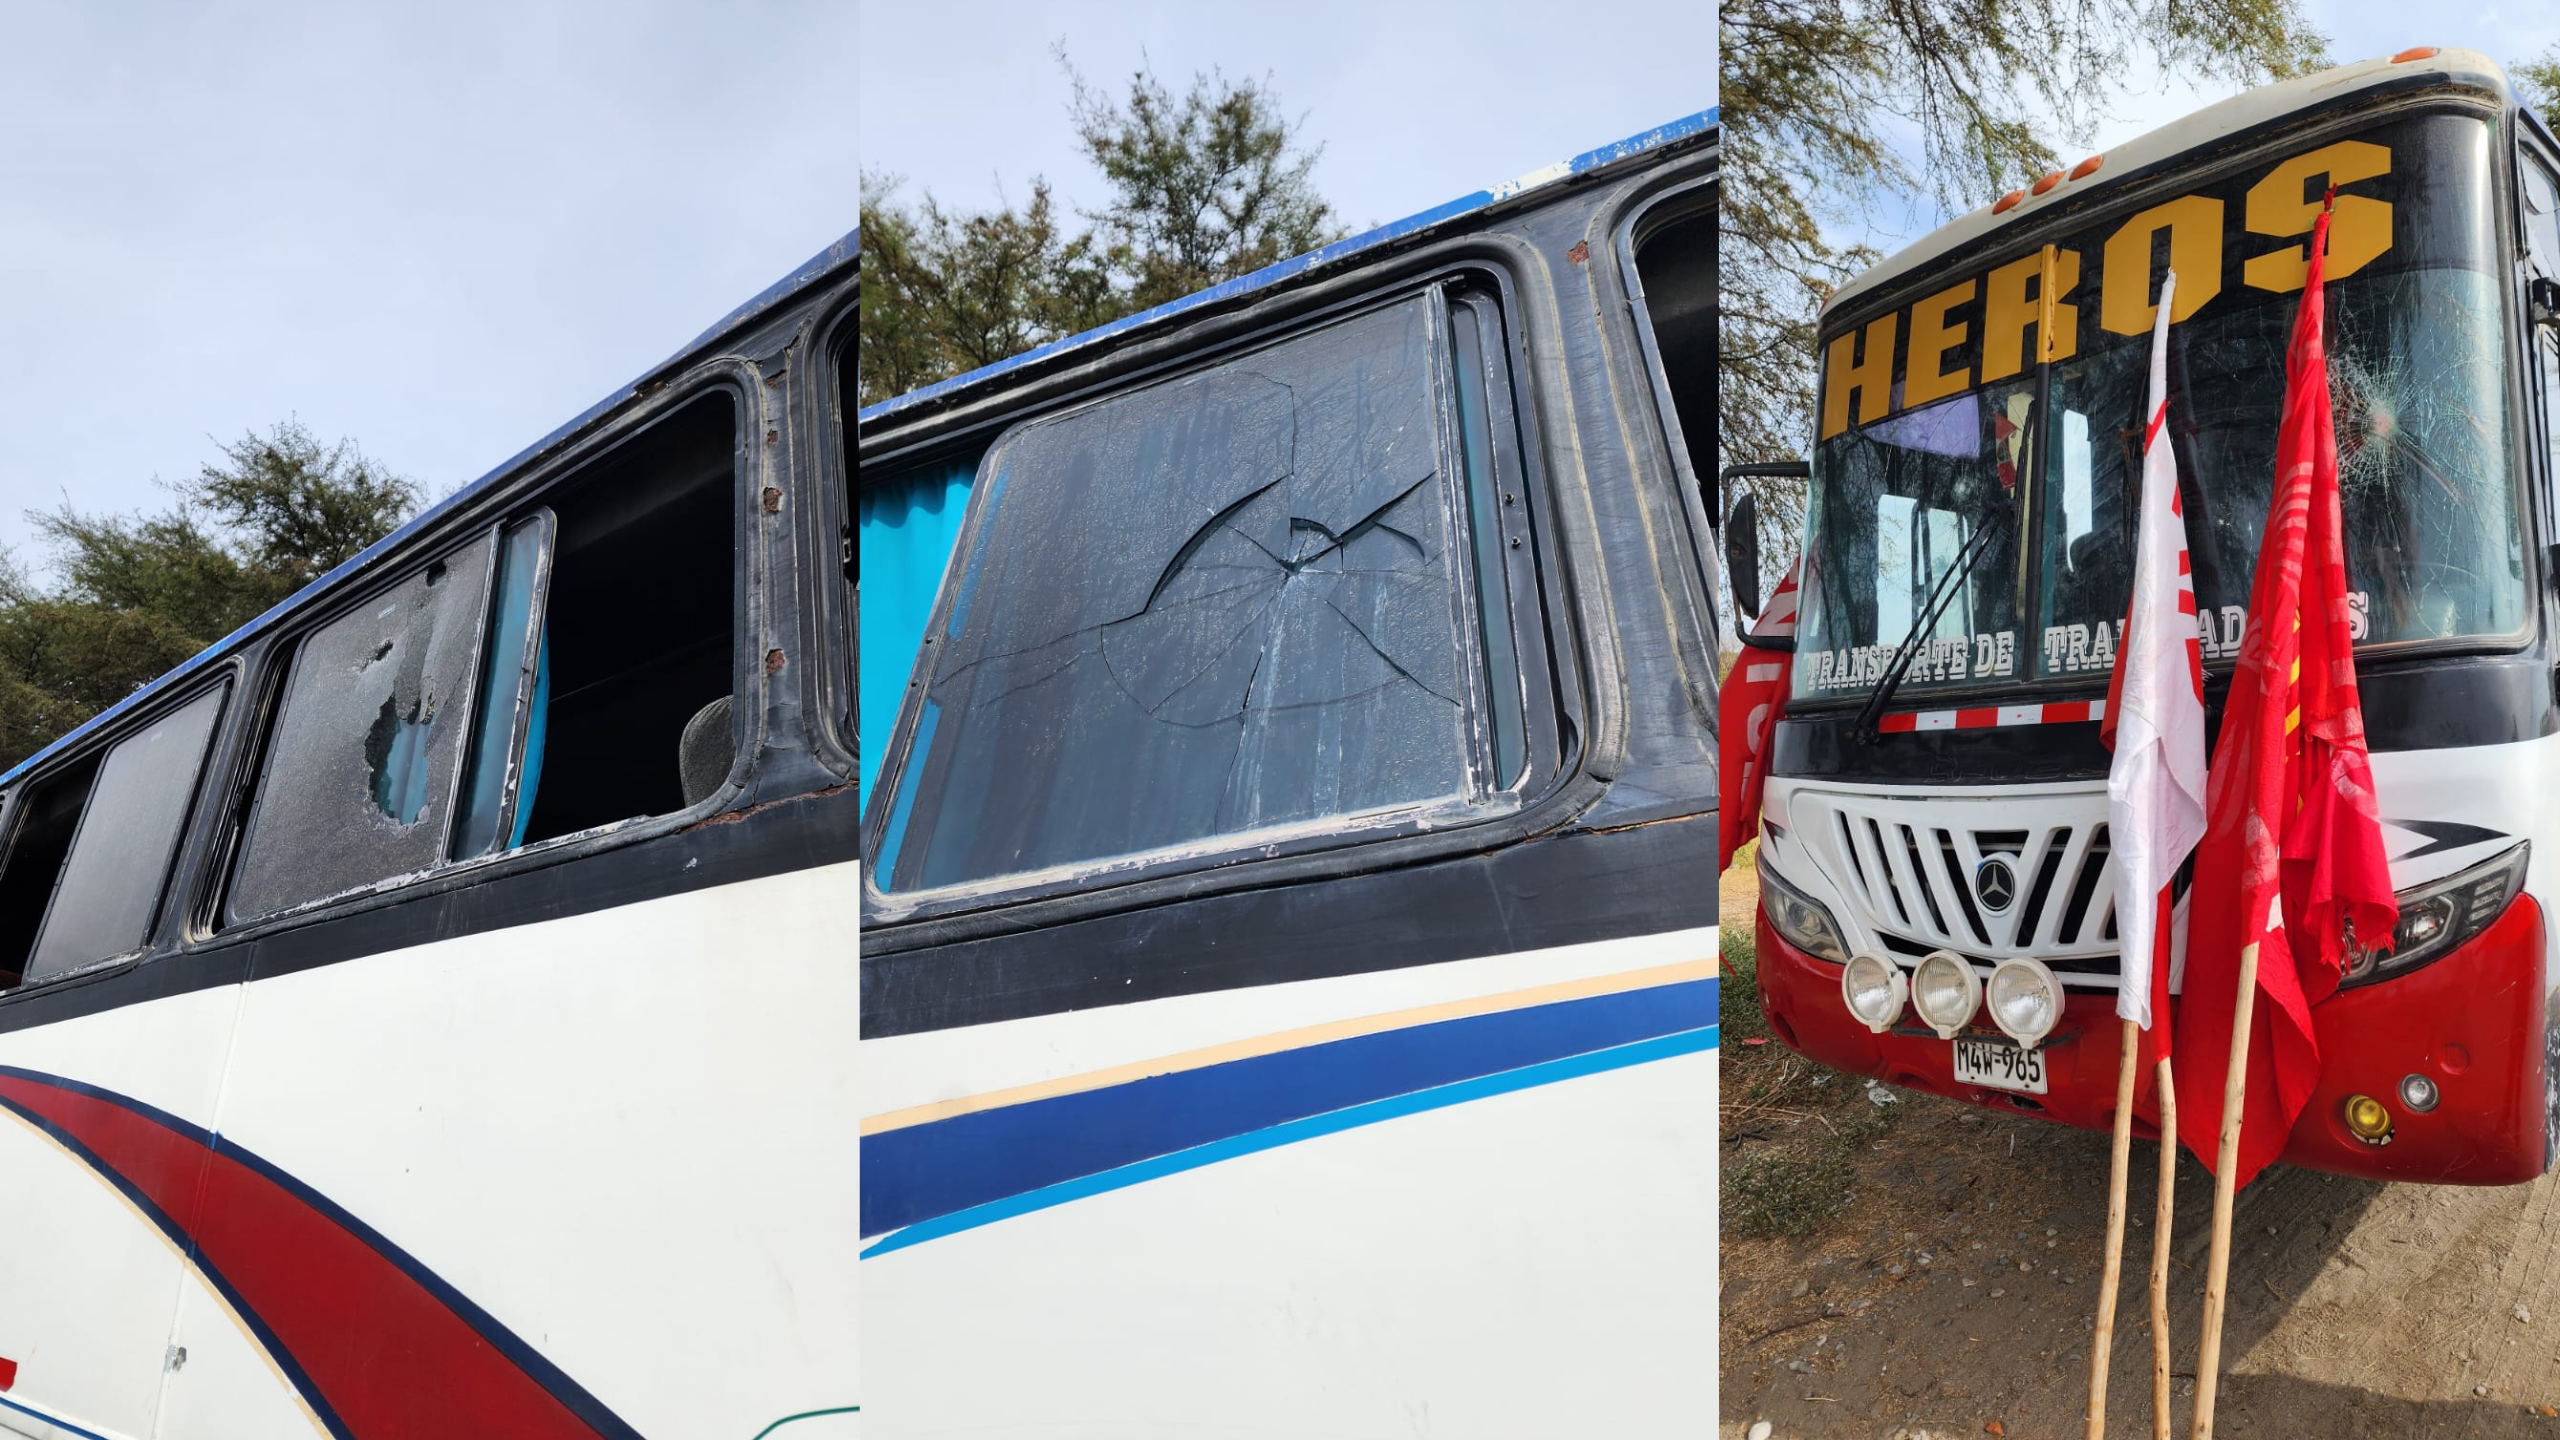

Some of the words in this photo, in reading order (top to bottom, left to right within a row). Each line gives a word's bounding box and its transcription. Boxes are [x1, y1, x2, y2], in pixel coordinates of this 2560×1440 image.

[1821, 139, 2393, 441] HEROS
[1974, 630, 2015, 678] DE
[1956, 1040, 2041, 1083] M4W-965
